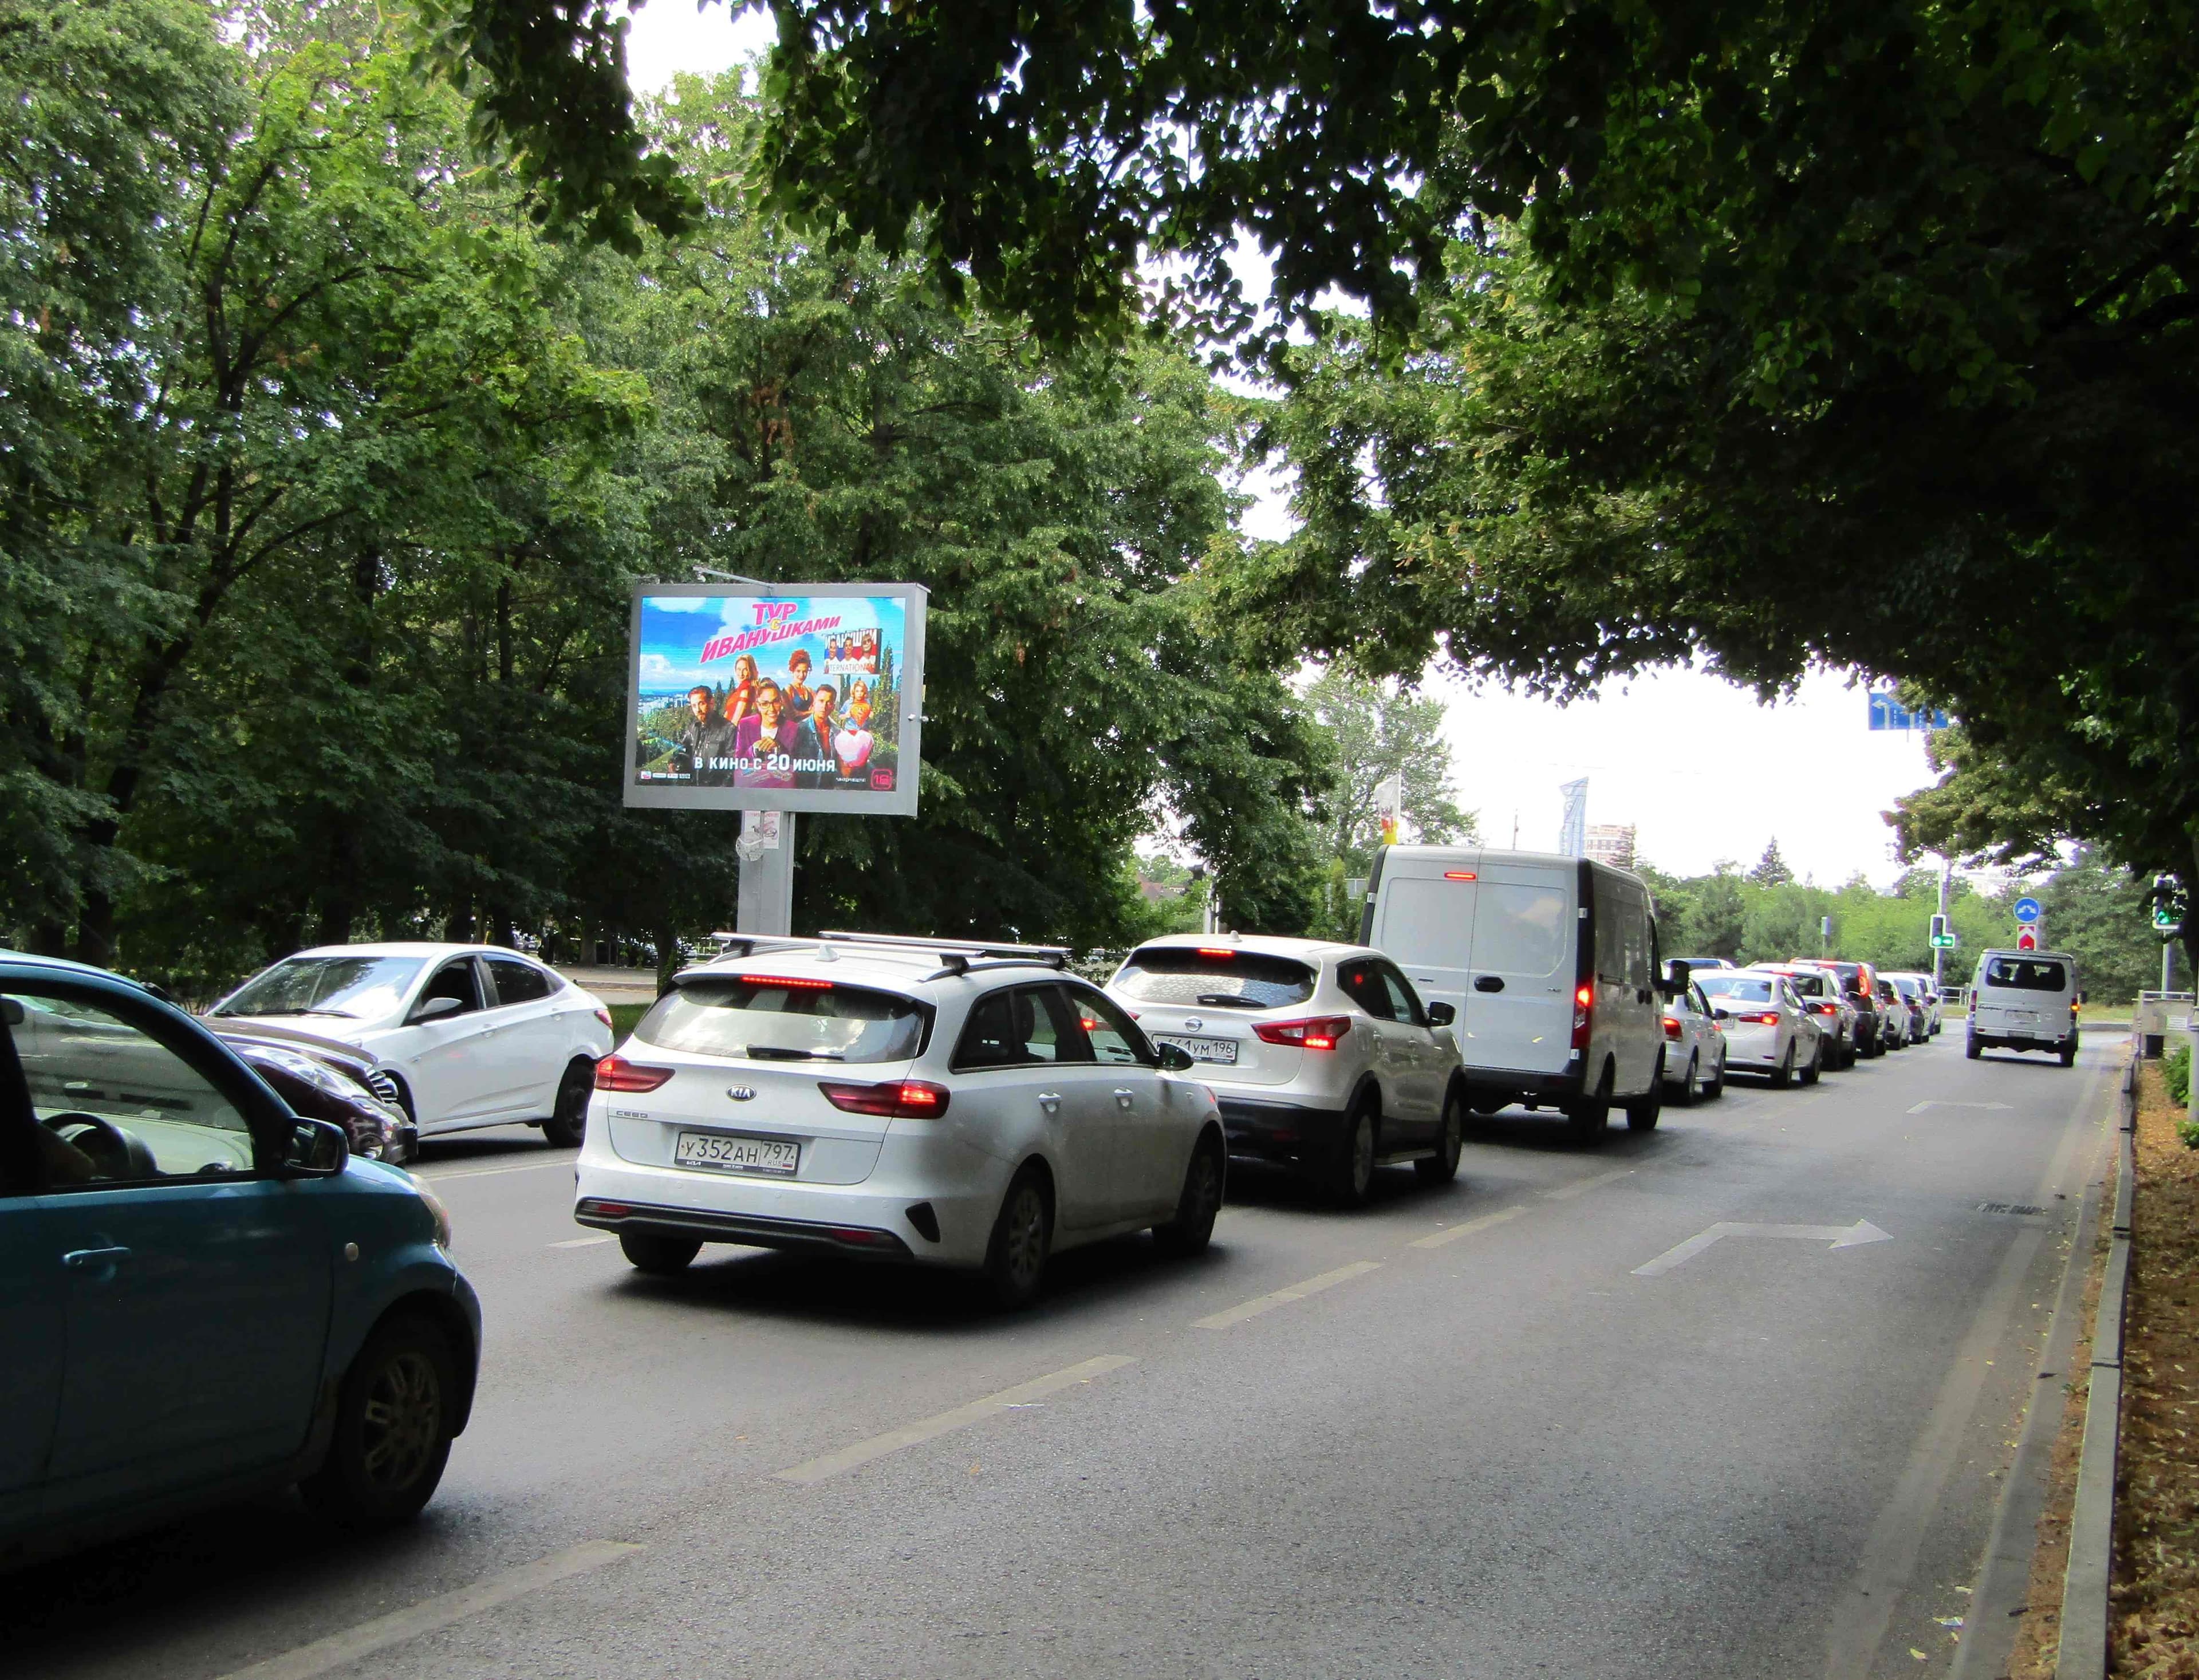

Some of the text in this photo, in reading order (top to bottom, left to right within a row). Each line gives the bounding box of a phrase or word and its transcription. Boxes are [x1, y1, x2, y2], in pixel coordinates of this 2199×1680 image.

[752, 604, 797, 625] ТУР
[700, 616, 841, 663] ИВАНУШКАМИ
[694, 758, 703, 769] В
[710, 758, 748, 770] КИНО
[767, 754, 790, 771] 20
[793, 759, 836, 772] ИЮНЯ
[1213, 1042, 1232, 1054] 196
[731, 1088, 751, 1098] KIA
[685, 1138, 793, 1164] У352АН 797
